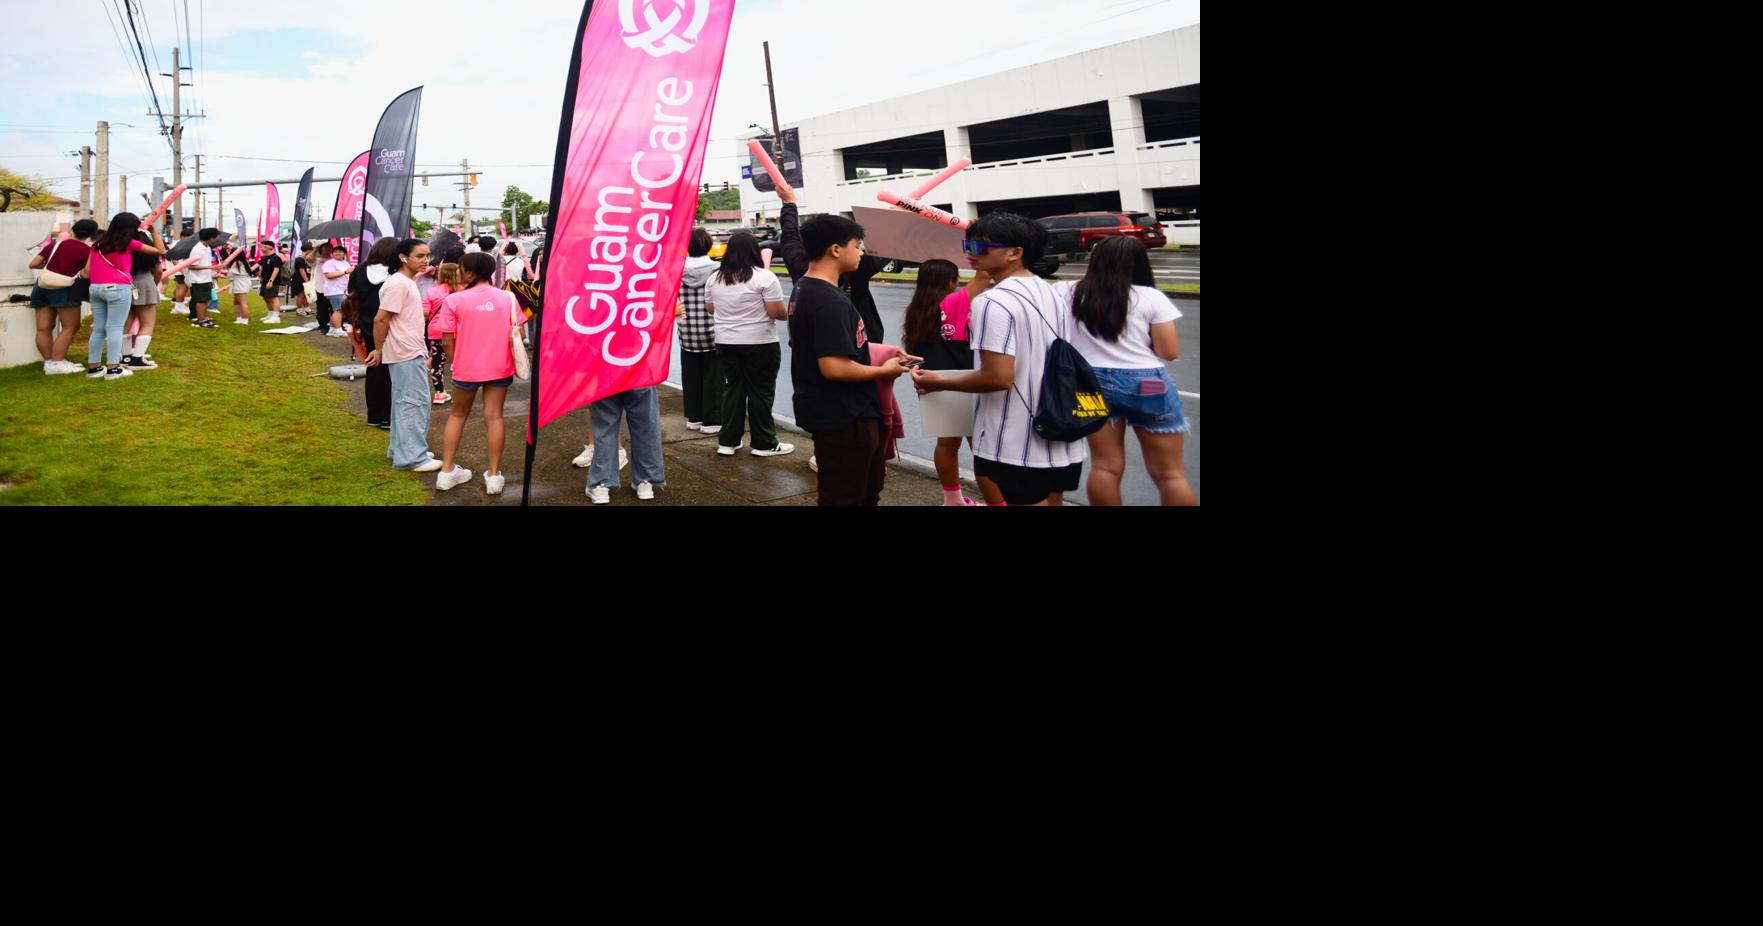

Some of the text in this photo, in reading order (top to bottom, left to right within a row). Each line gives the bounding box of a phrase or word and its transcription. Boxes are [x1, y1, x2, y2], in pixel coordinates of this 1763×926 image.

[381, 149, 405, 158] Guam
[375, 156, 404, 165] Cancer
[384, 163, 404, 173] Care
[895, 200, 922, 214] PINK
[602, 77, 693, 366] CancerCare
[565, 186, 634, 335] Guam
